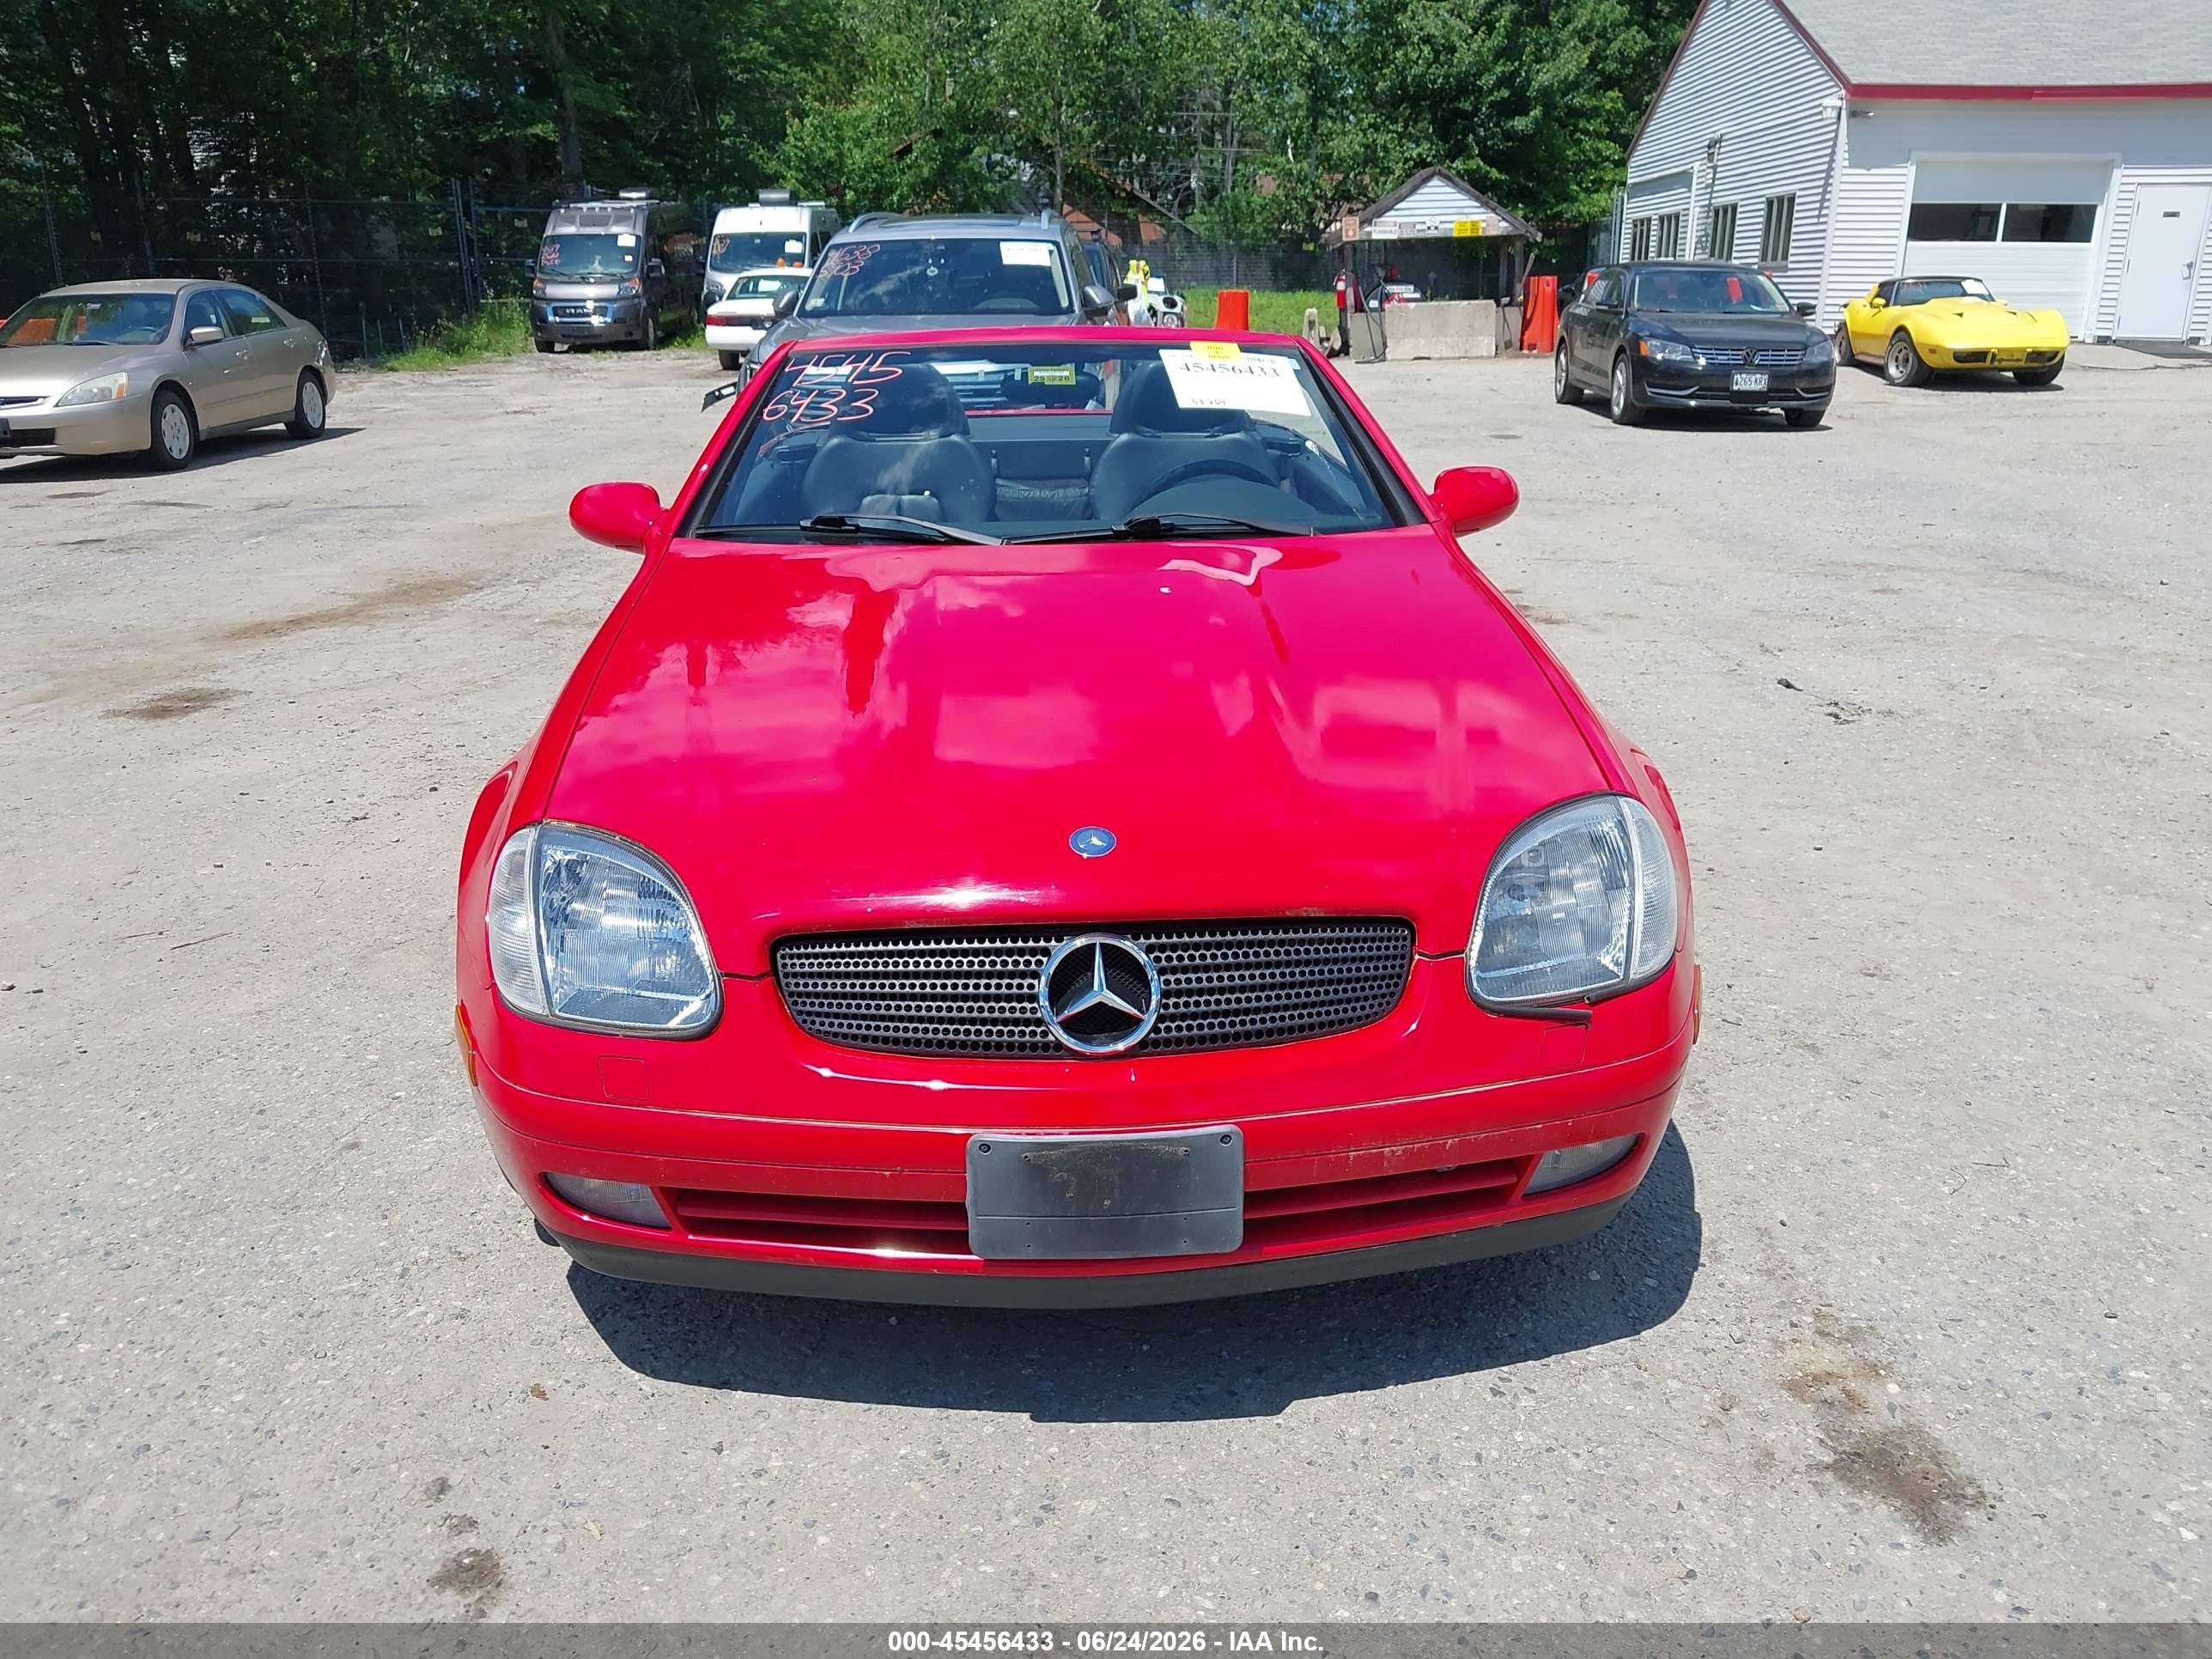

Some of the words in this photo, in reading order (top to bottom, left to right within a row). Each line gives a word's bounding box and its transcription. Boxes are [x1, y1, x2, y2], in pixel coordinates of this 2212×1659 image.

[785, 351, 912, 386] 4545
[1180, 362, 1280, 378] 45456433
[763, 388, 879, 423] 6433
